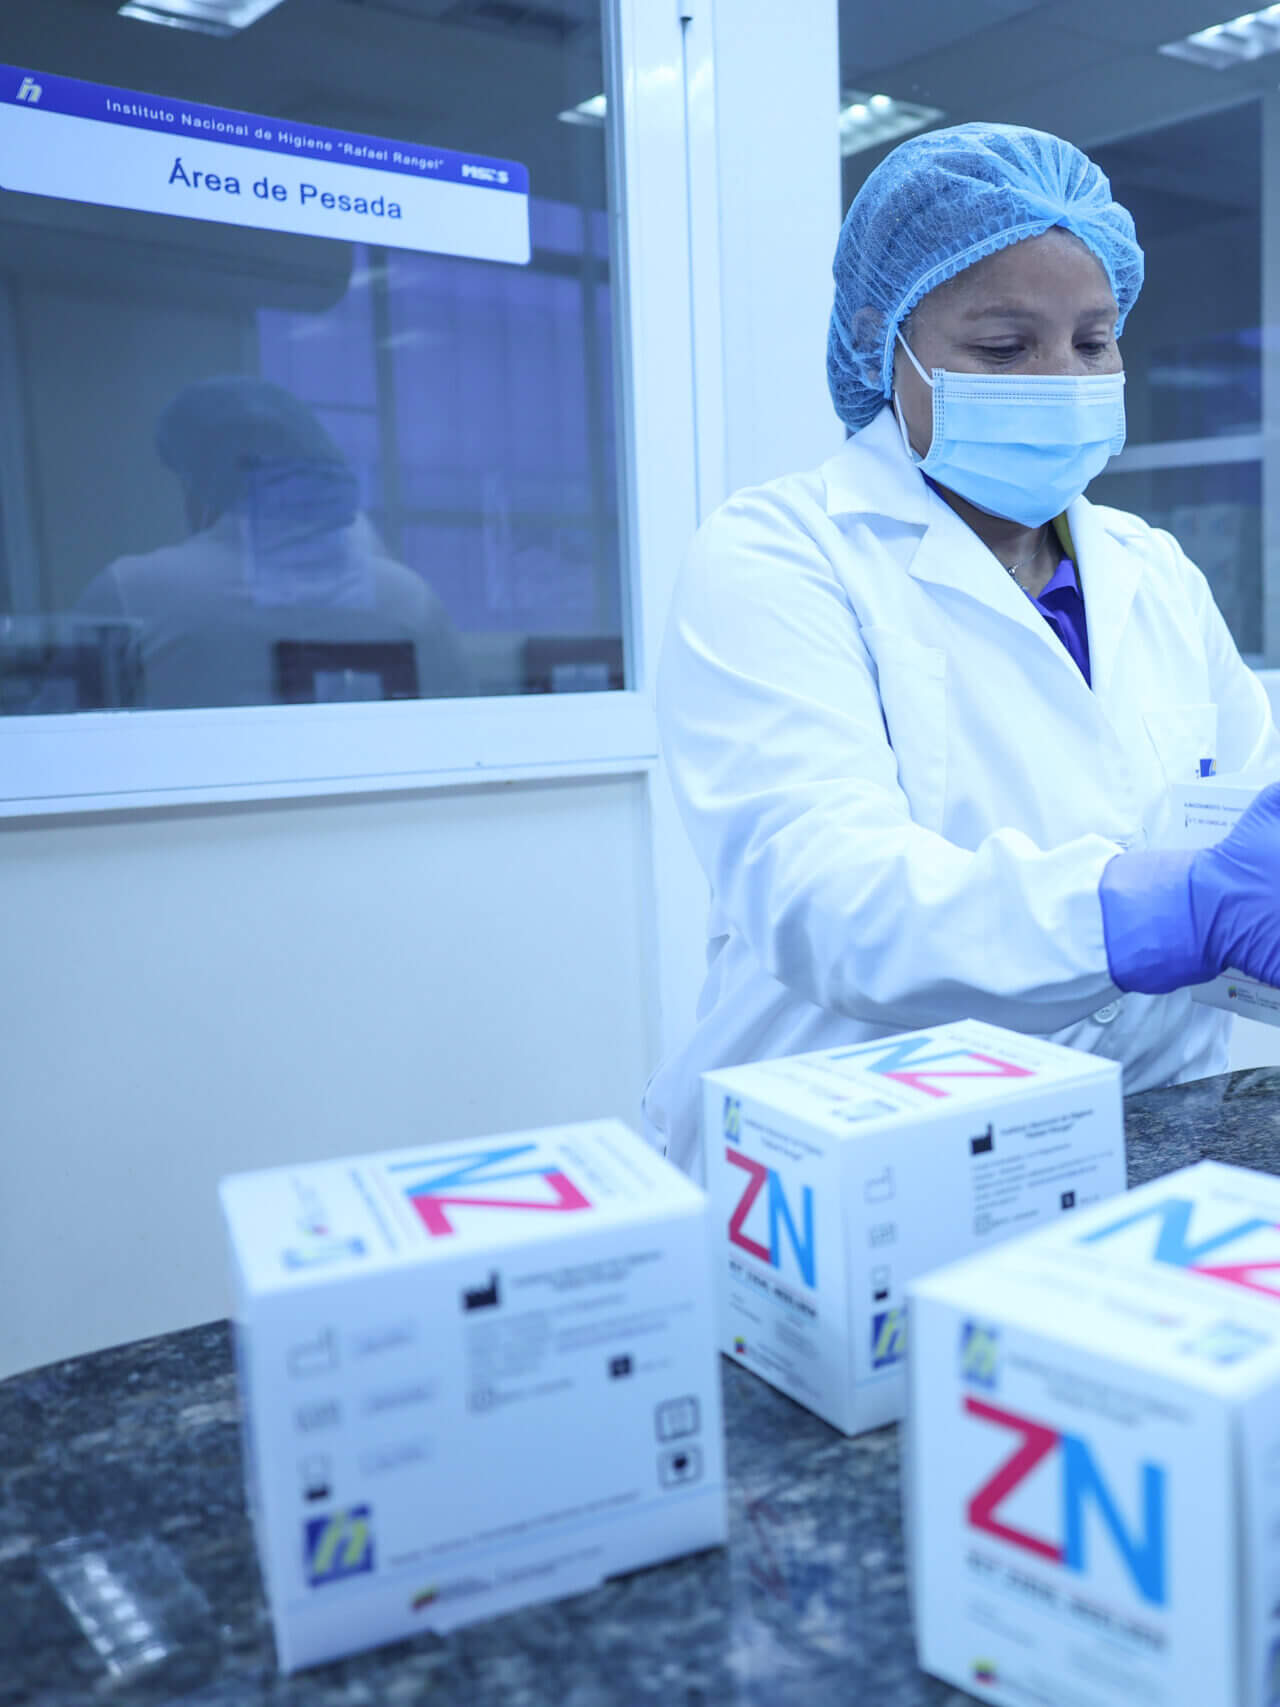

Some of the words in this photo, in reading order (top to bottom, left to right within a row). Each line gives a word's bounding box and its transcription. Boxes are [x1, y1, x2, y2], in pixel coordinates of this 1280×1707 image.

[106, 99, 175, 122] Instituto
[182, 113, 249, 136] Nacional
[255, 127, 272, 141] de
[278, 131, 332, 151] Higiene
[168, 157, 241, 194] Área
[252, 177, 287, 202] de
[300, 183, 402, 219] Pesada
[724, 1146, 817, 1290] ZN
[961, 1394, 1167, 1609] ZN
